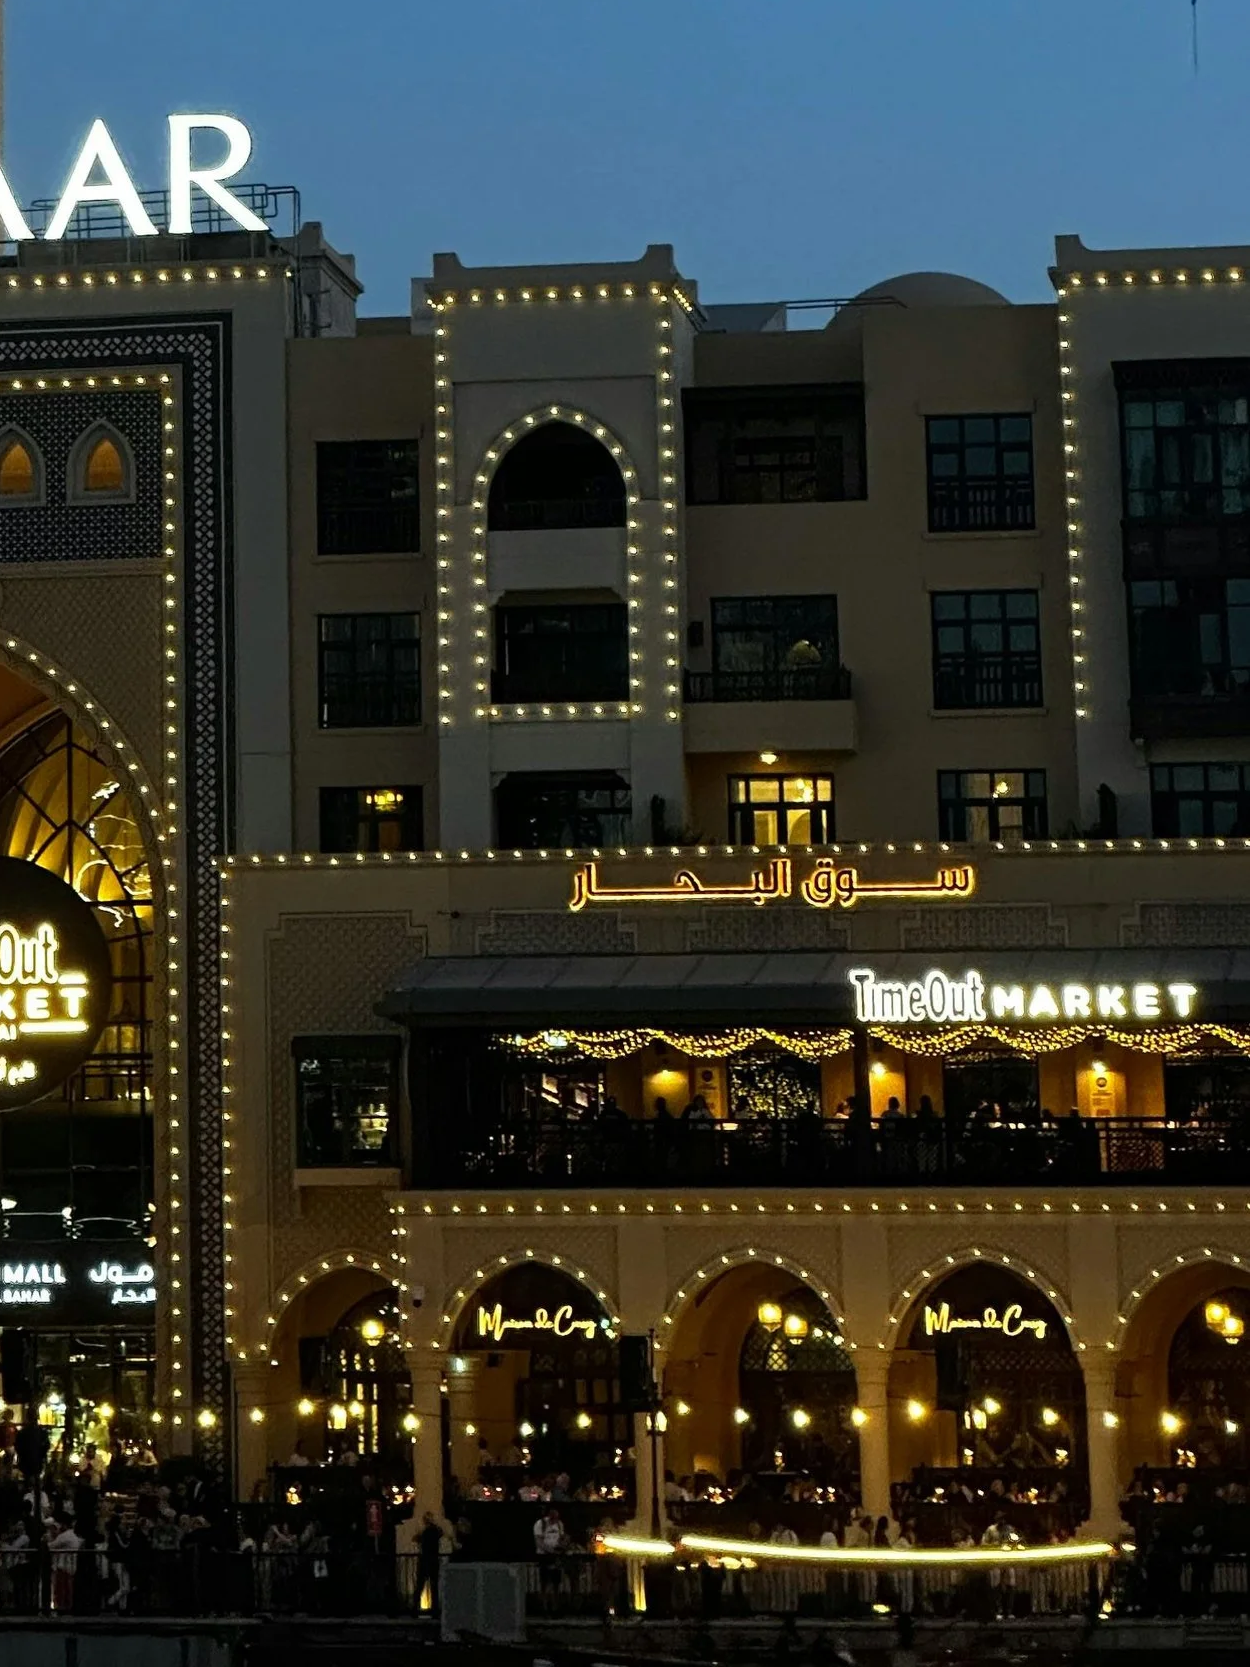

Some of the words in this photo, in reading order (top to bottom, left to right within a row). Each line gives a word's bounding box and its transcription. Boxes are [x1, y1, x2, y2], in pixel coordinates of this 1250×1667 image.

[570, 858, 791, 911] البحار
[802, 857, 972, 907] سوق
[991, 983, 1198, 1018] MARKET
[2, 1263, 67, 1284] MALL
[3, 1288, 52, 1303] BAHAR
